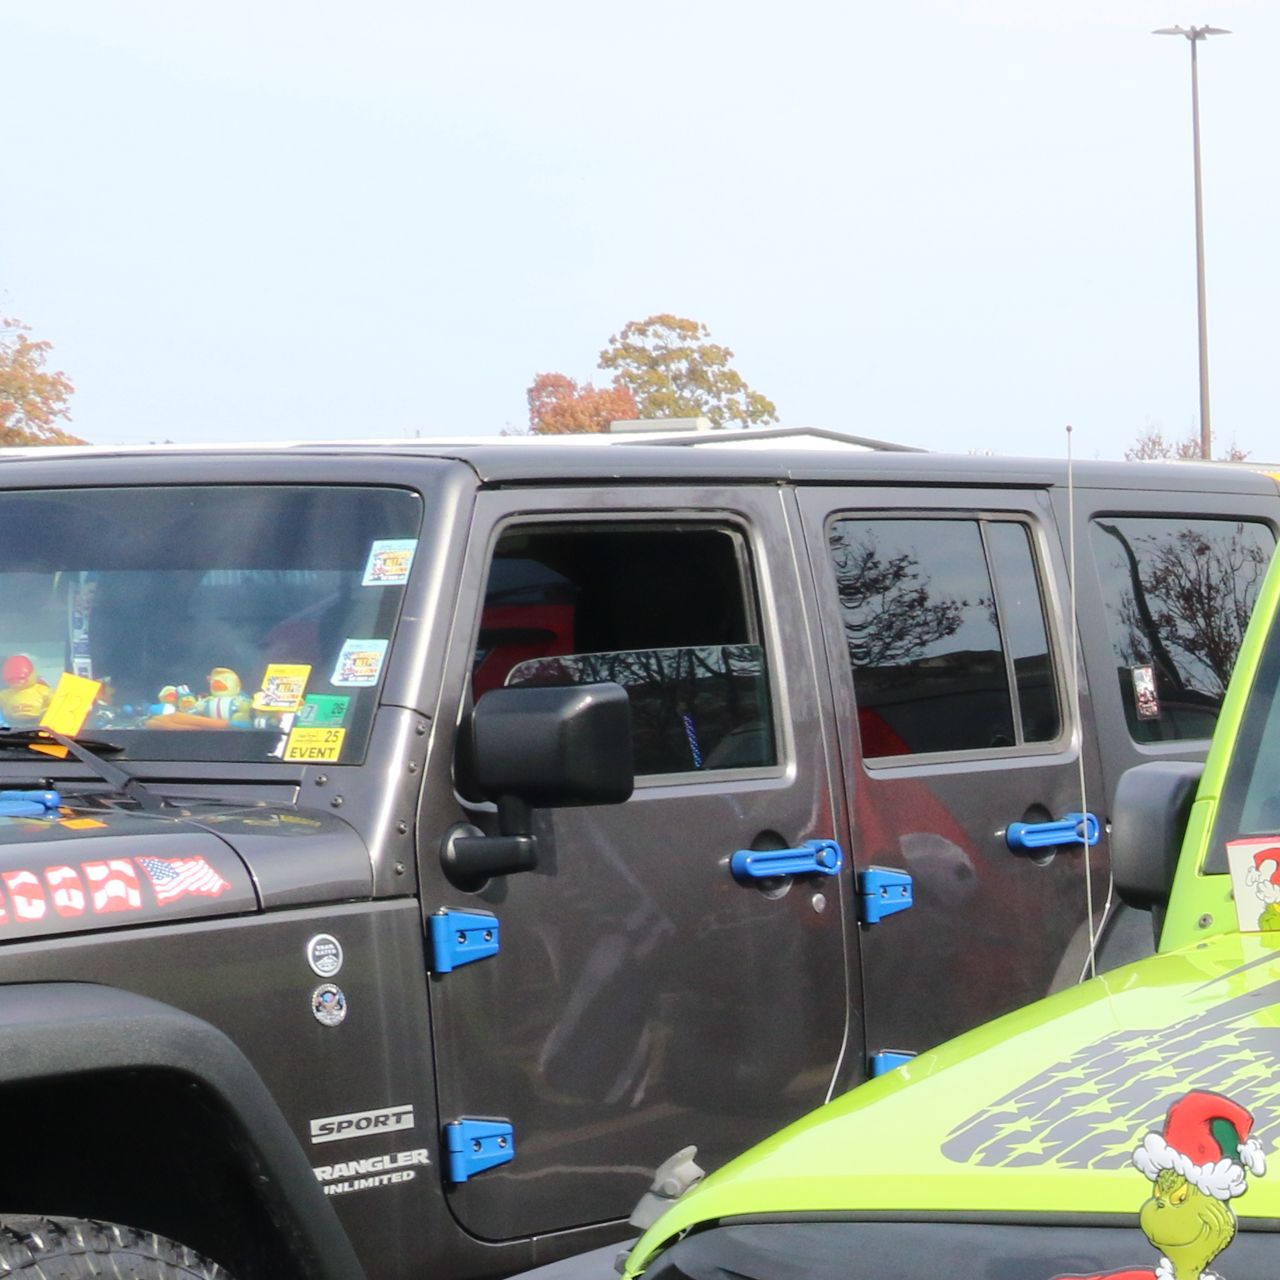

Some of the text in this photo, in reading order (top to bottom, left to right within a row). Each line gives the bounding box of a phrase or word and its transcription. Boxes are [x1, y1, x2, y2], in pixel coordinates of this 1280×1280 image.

[324, 729, 341, 743] 25
[289, 746, 336, 759] EVENT
[318, 1112, 405, 1136] SPORT
